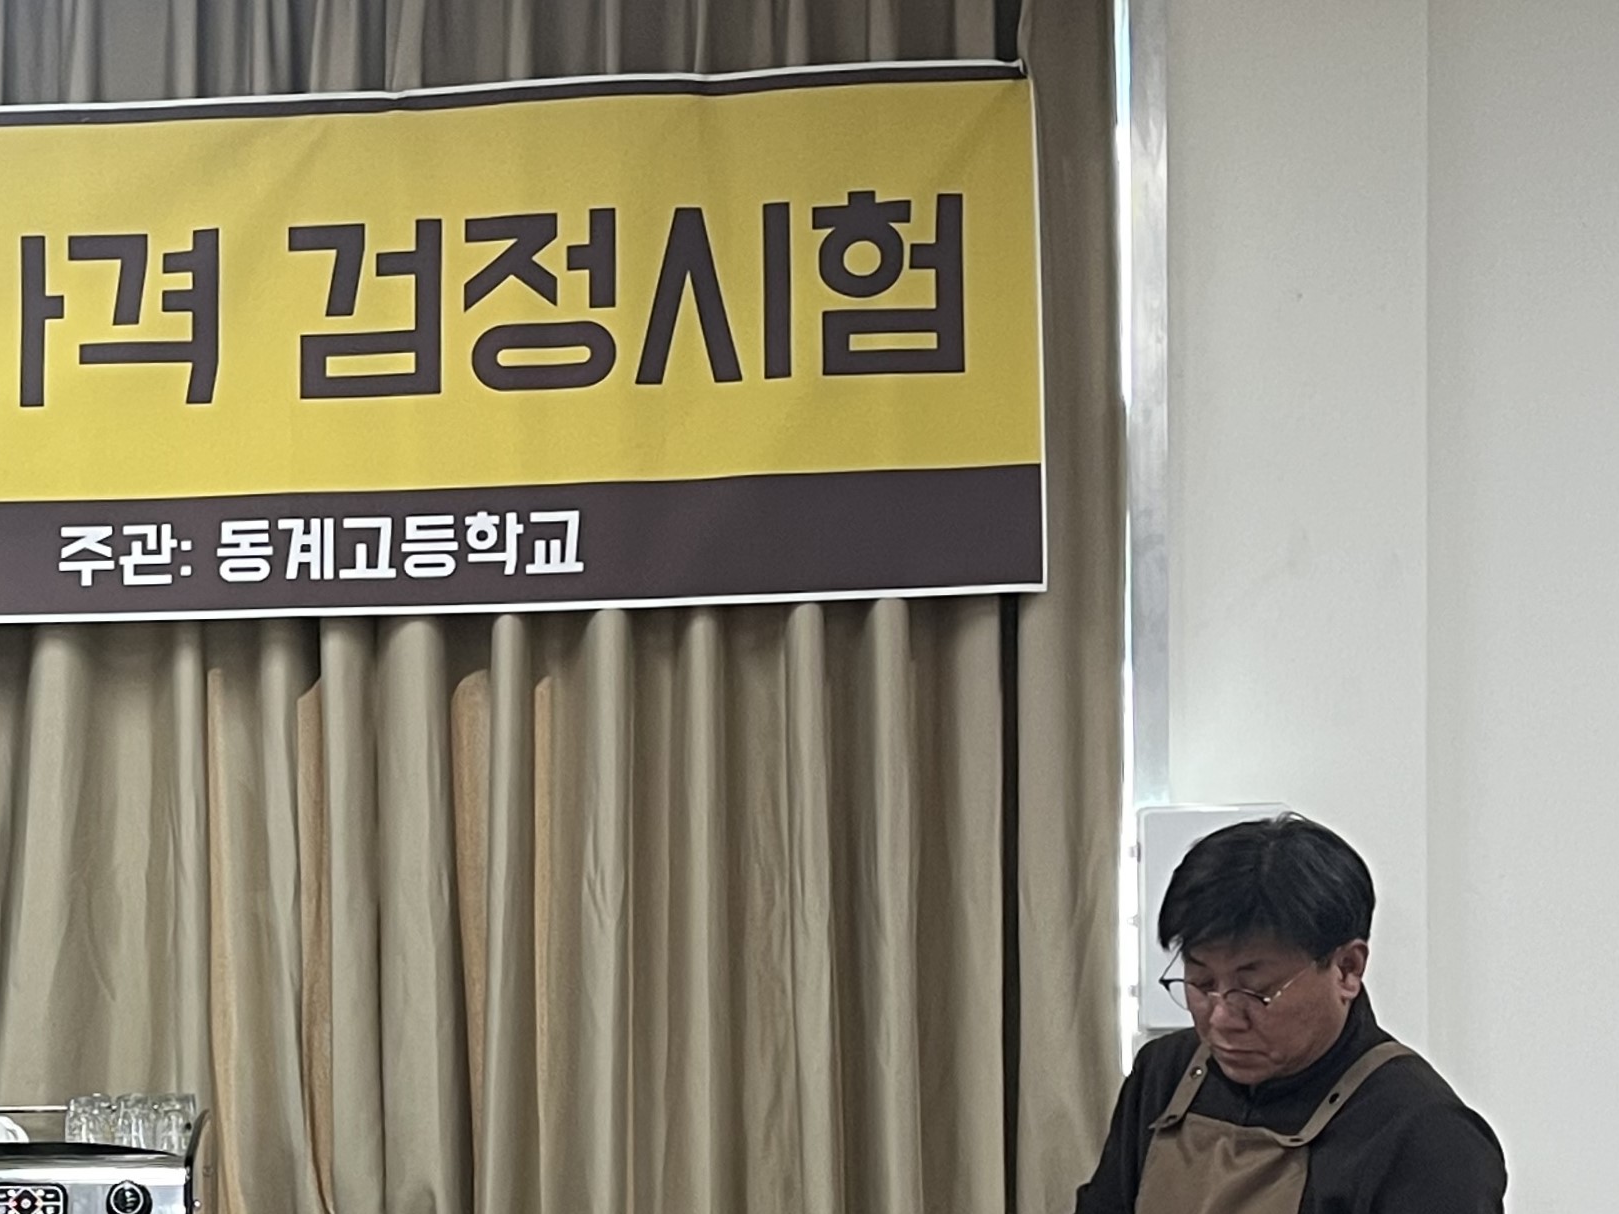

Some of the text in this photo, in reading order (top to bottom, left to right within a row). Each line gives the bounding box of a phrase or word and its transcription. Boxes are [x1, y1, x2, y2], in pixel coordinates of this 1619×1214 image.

[288, 190, 966, 400] 검정시험
[58, 509, 585, 586] 주관: 동계고등학교
